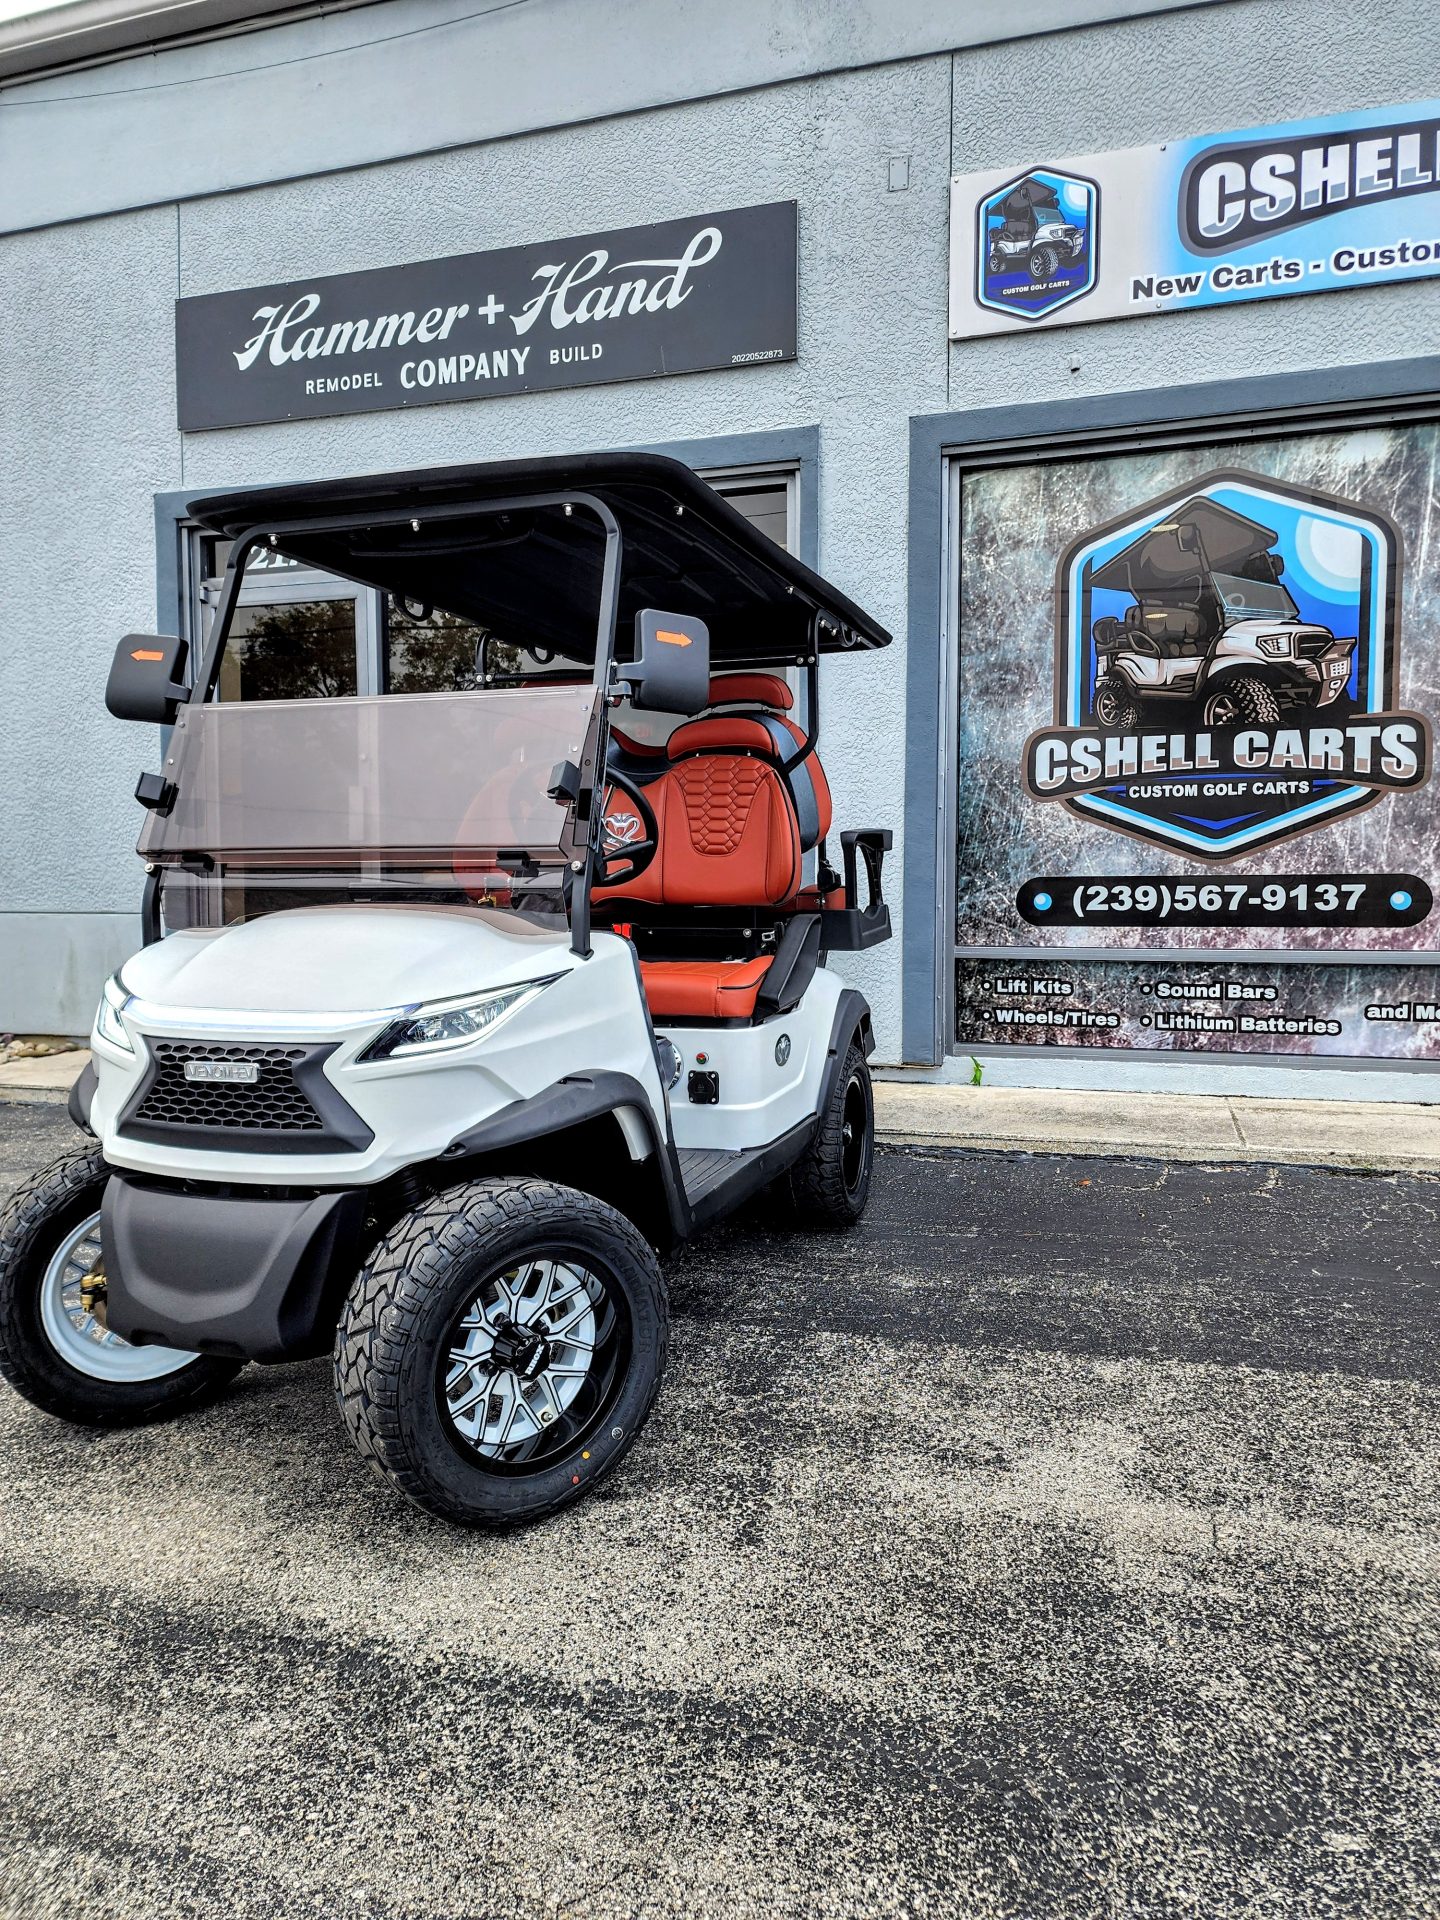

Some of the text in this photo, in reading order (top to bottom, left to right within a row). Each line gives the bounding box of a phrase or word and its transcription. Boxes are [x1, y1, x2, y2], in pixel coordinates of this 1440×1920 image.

[1198, 130, 1440, 239] CSHEL
[1132, 274, 1202, 301] New
[1212, 261, 1300, 289] Carts
[1333, 242, 1440, 272] Custo
[1002, 280, 1070, 295] CUSTOM GOLF CARTS
[233, 227, 723, 371] Hammer + Hand
[731, 349, 783, 363] 20220522873
[305, 343, 603, 395] REMODEL COMPANY BUILD
[1035, 723, 1418, 790] CSHELL CARTS
[1128, 780, 1310, 799] CUSTOM GOLF CARTS
[1072, 883, 1367, 918] (239)567-9137
[996, 980, 1073, 995] Lift Kits
[1157, 982, 1277, 1000] Sound Bars
[996, 1010, 1118, 1027] Wheels/Tires
[1366, 1004, 1409, 1019] and
[1157, 1015, 1340, 1034] Lithium Batteries
